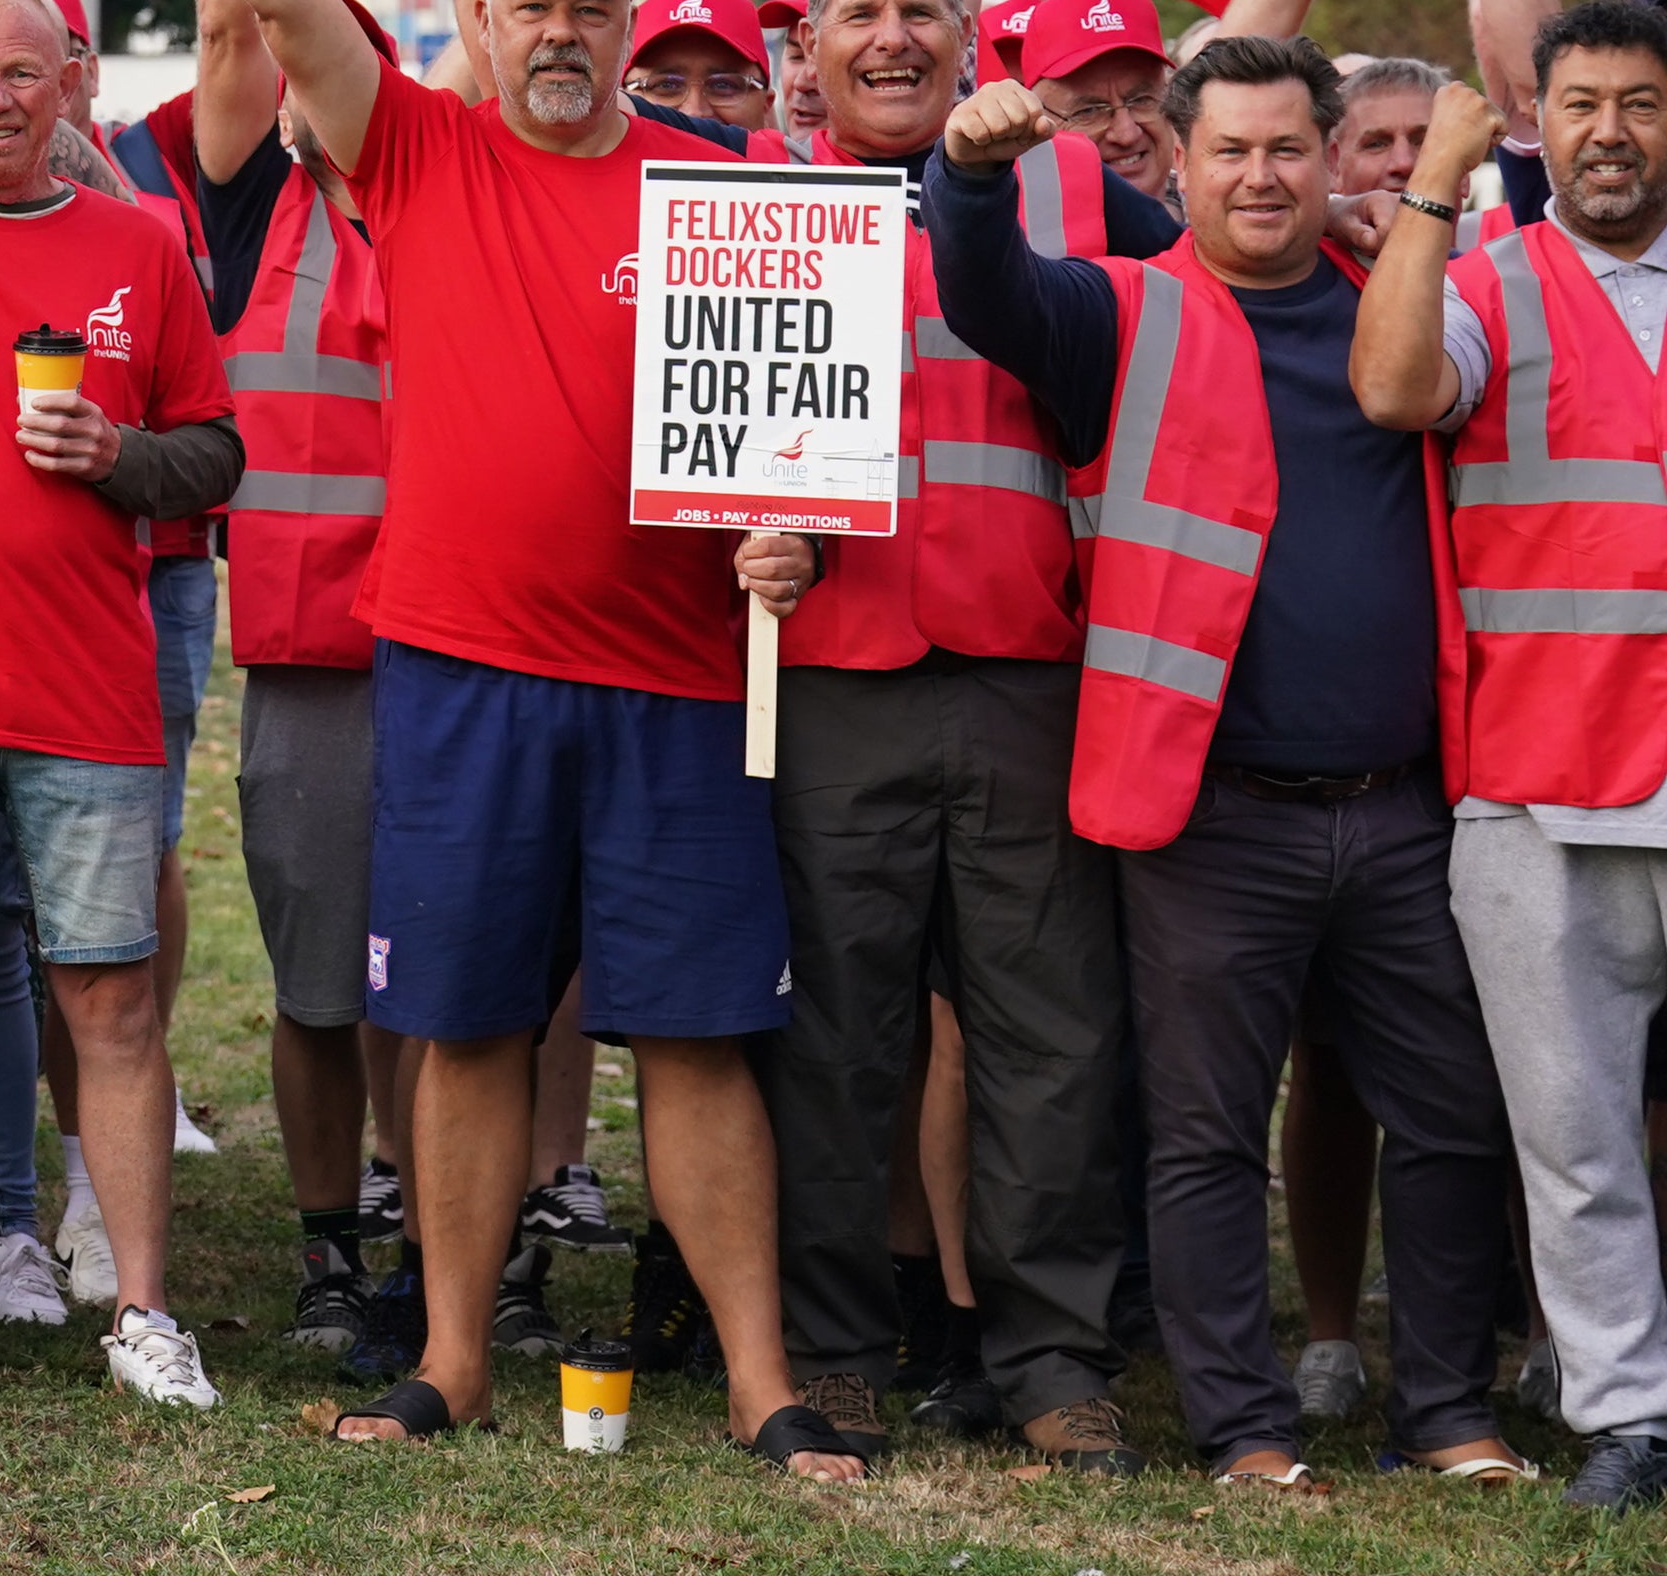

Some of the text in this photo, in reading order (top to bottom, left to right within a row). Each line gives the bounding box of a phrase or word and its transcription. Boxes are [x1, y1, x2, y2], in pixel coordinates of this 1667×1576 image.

[667, 199, 881, 246] FELIXSTOWE
[666, 246, 823, 290] DOCKERS
[664, 294, 833, 354] UNITED
[662, 358, 870, 420] FOR FAIR
[660, 422, 748, 478] PAY
[673, 508, 852, 529] JOBS PAY CONDITIONS
